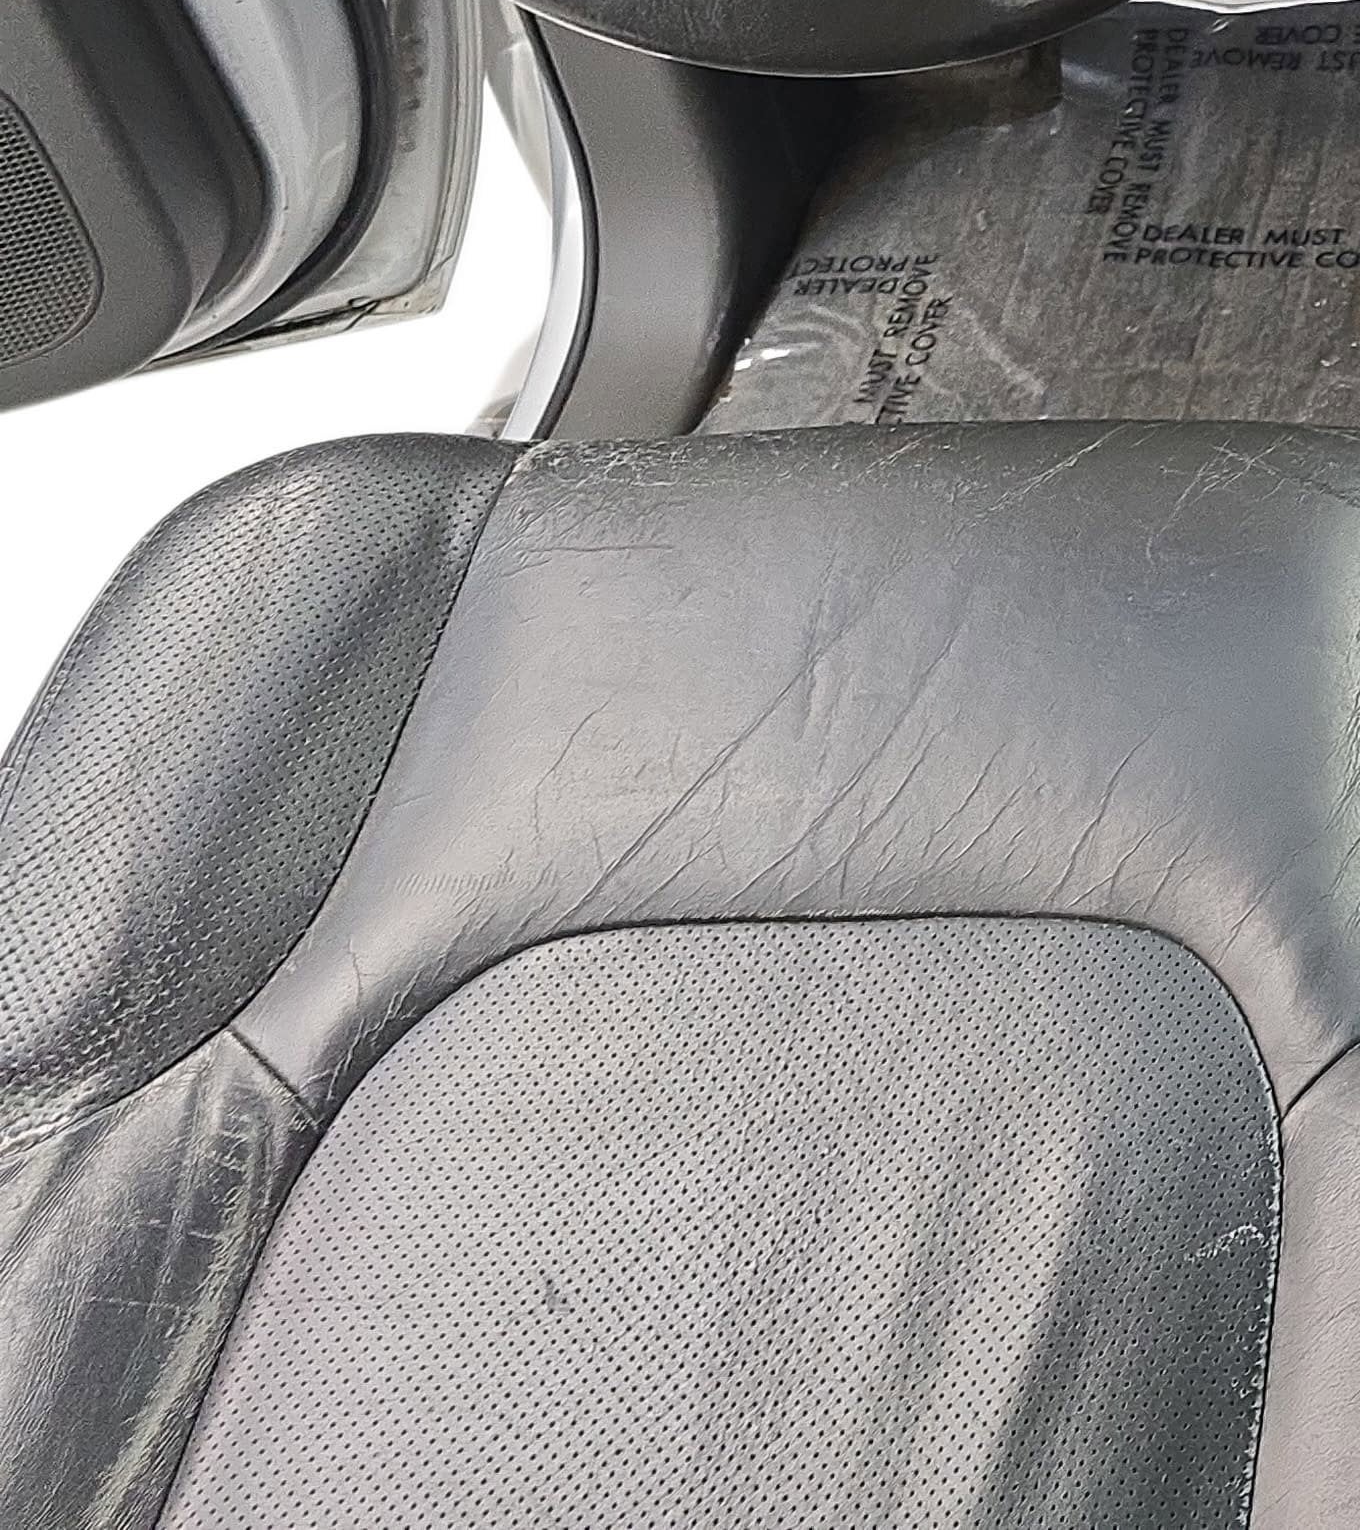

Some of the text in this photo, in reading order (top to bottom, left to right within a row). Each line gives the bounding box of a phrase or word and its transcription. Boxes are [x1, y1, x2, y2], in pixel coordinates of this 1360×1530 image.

[1255, 24, 1341, 46] COVER
[1191, 49, 1300, 71] REMOVE
[1103, 28, 1188, 263] DEALER MUST REMOVE
[1085, 157, 1128, 215] COVER
[1143, 224, 1245, 245] DEALER
[1263, 227, 1345, 246] MUST
[1134, 247, 1302, 269] PROTECTIVE
[793, 277, 900, 296] DEALER
[883, 254, 941, 338] REMOVE
[905, 295, 954, 367] COVER
